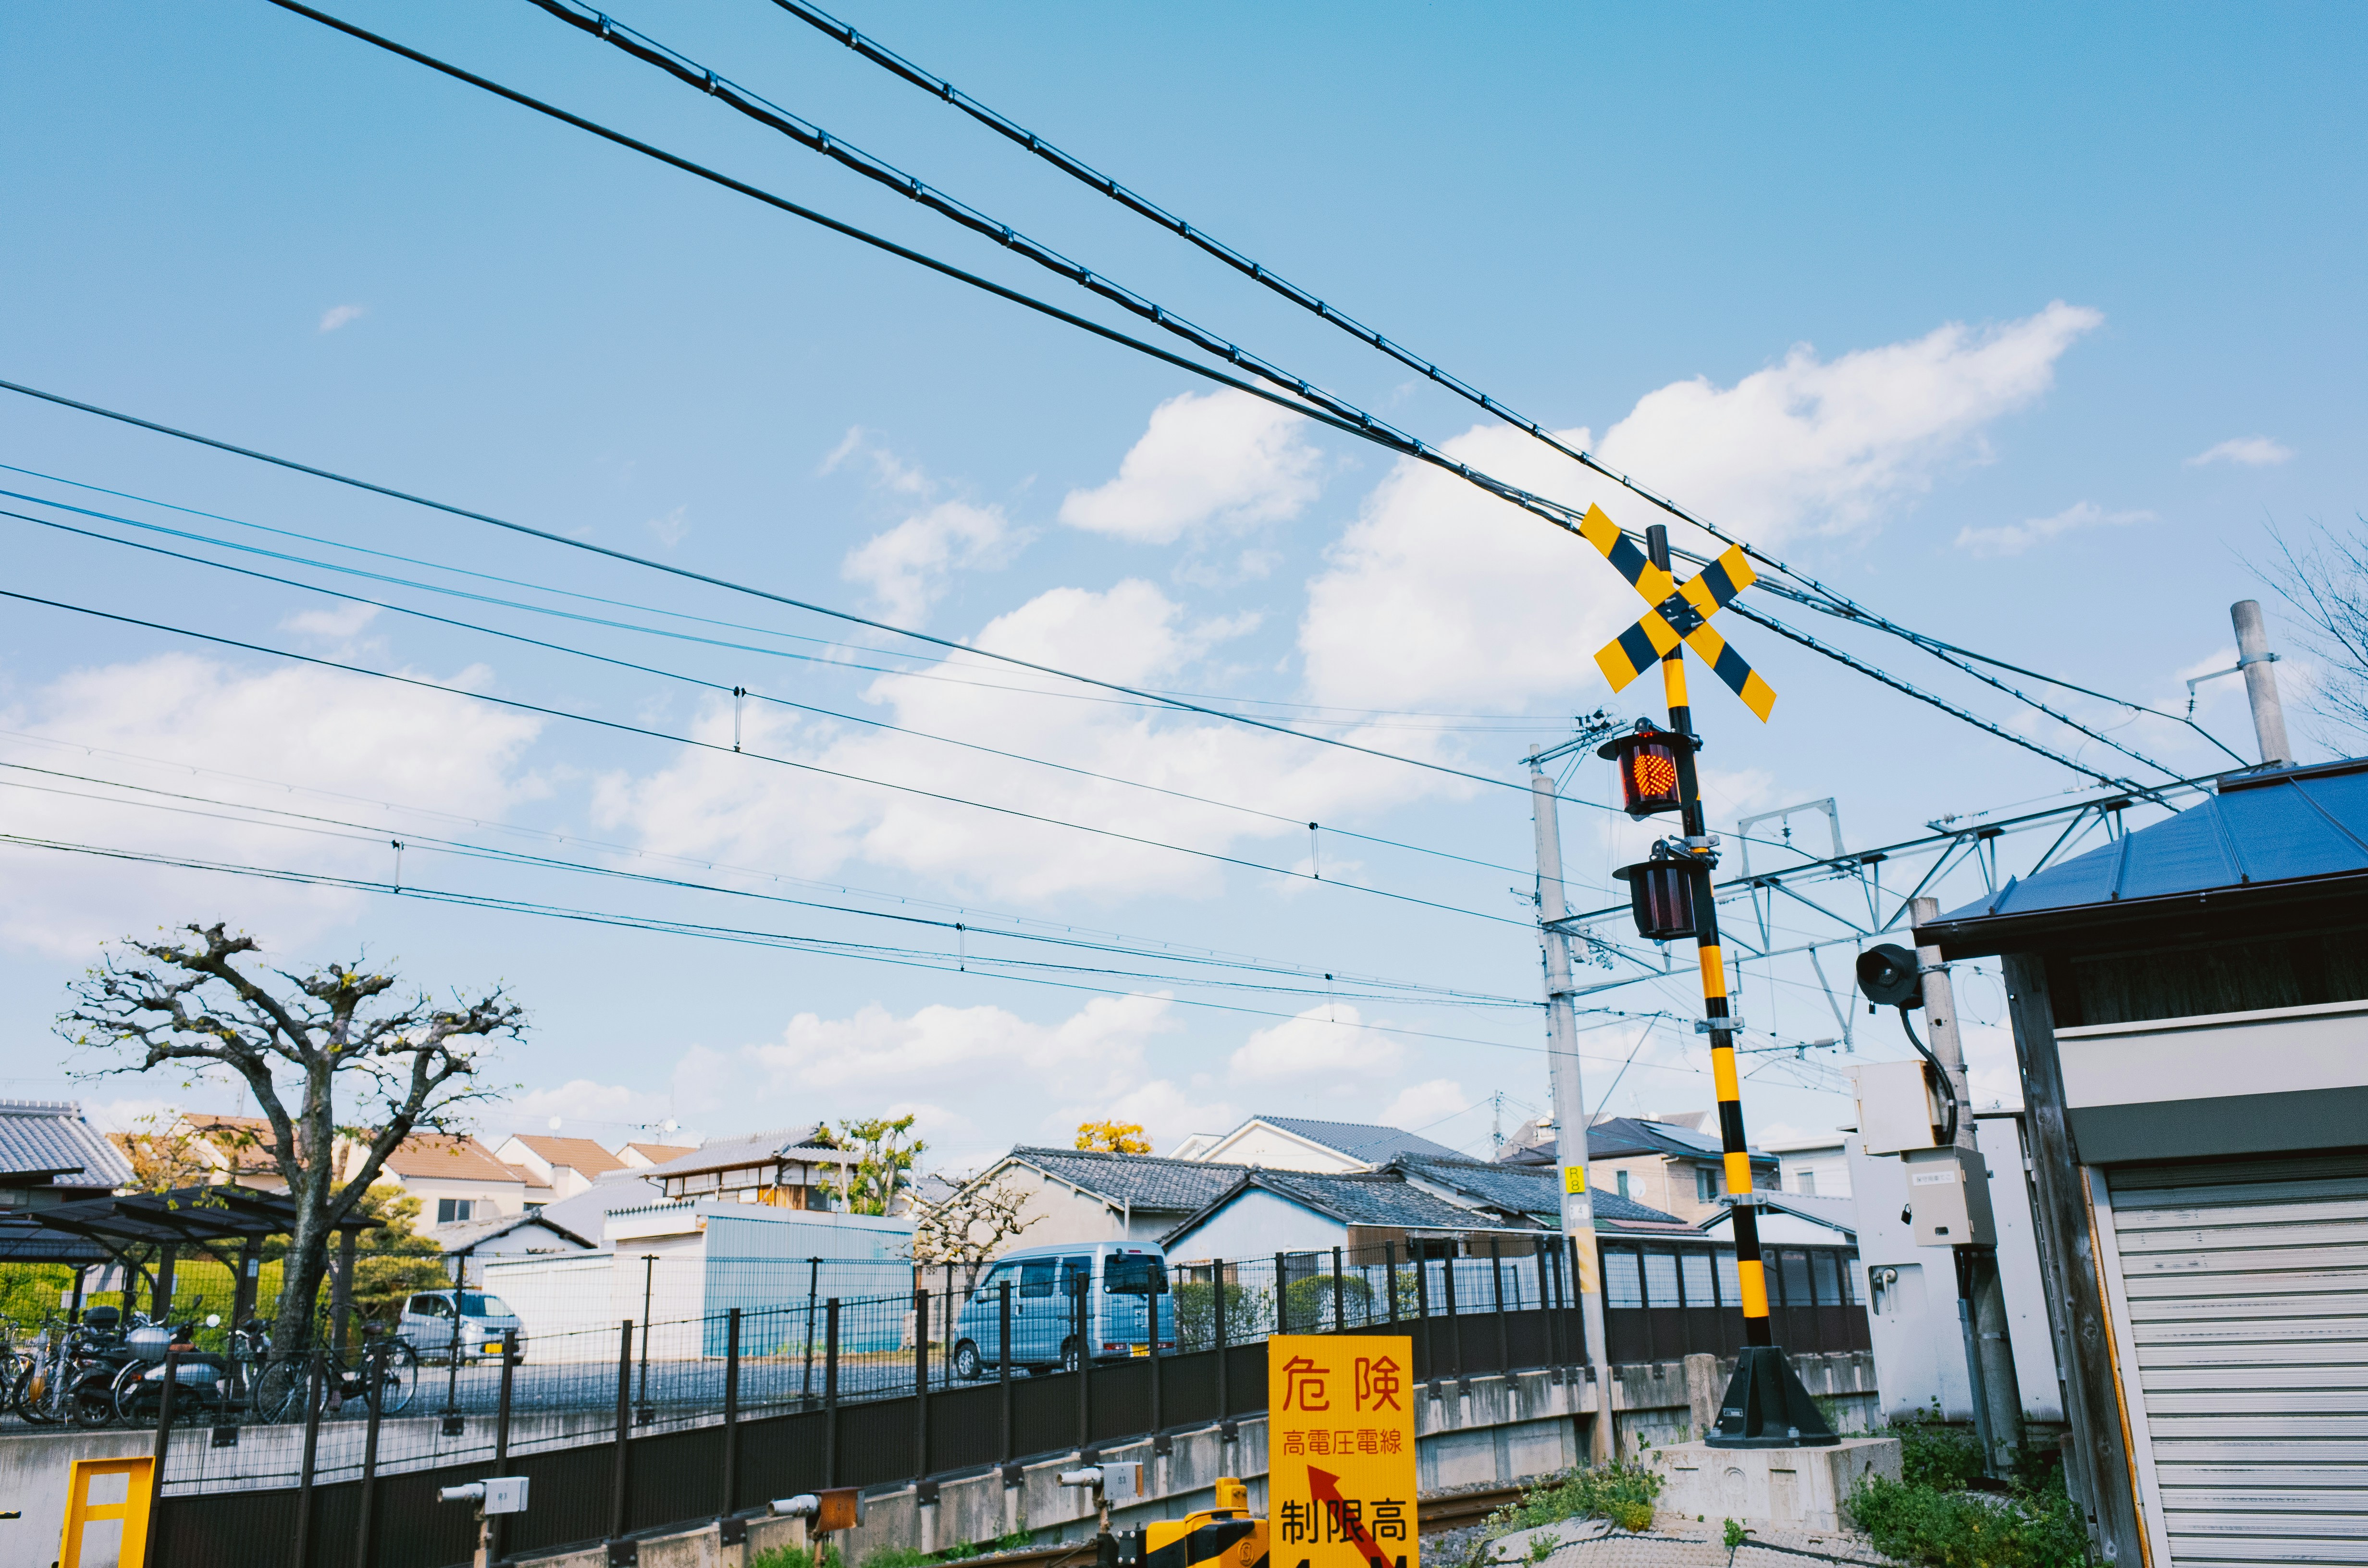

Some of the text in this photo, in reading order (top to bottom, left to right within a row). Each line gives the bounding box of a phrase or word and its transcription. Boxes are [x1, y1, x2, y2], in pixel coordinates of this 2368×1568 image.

[1283, 1355, 1401, 1411] 危険
[1283, 1428, 1402, 1456] 高電圧電線
[1281, 1497, 1406, 1545] 制限高
